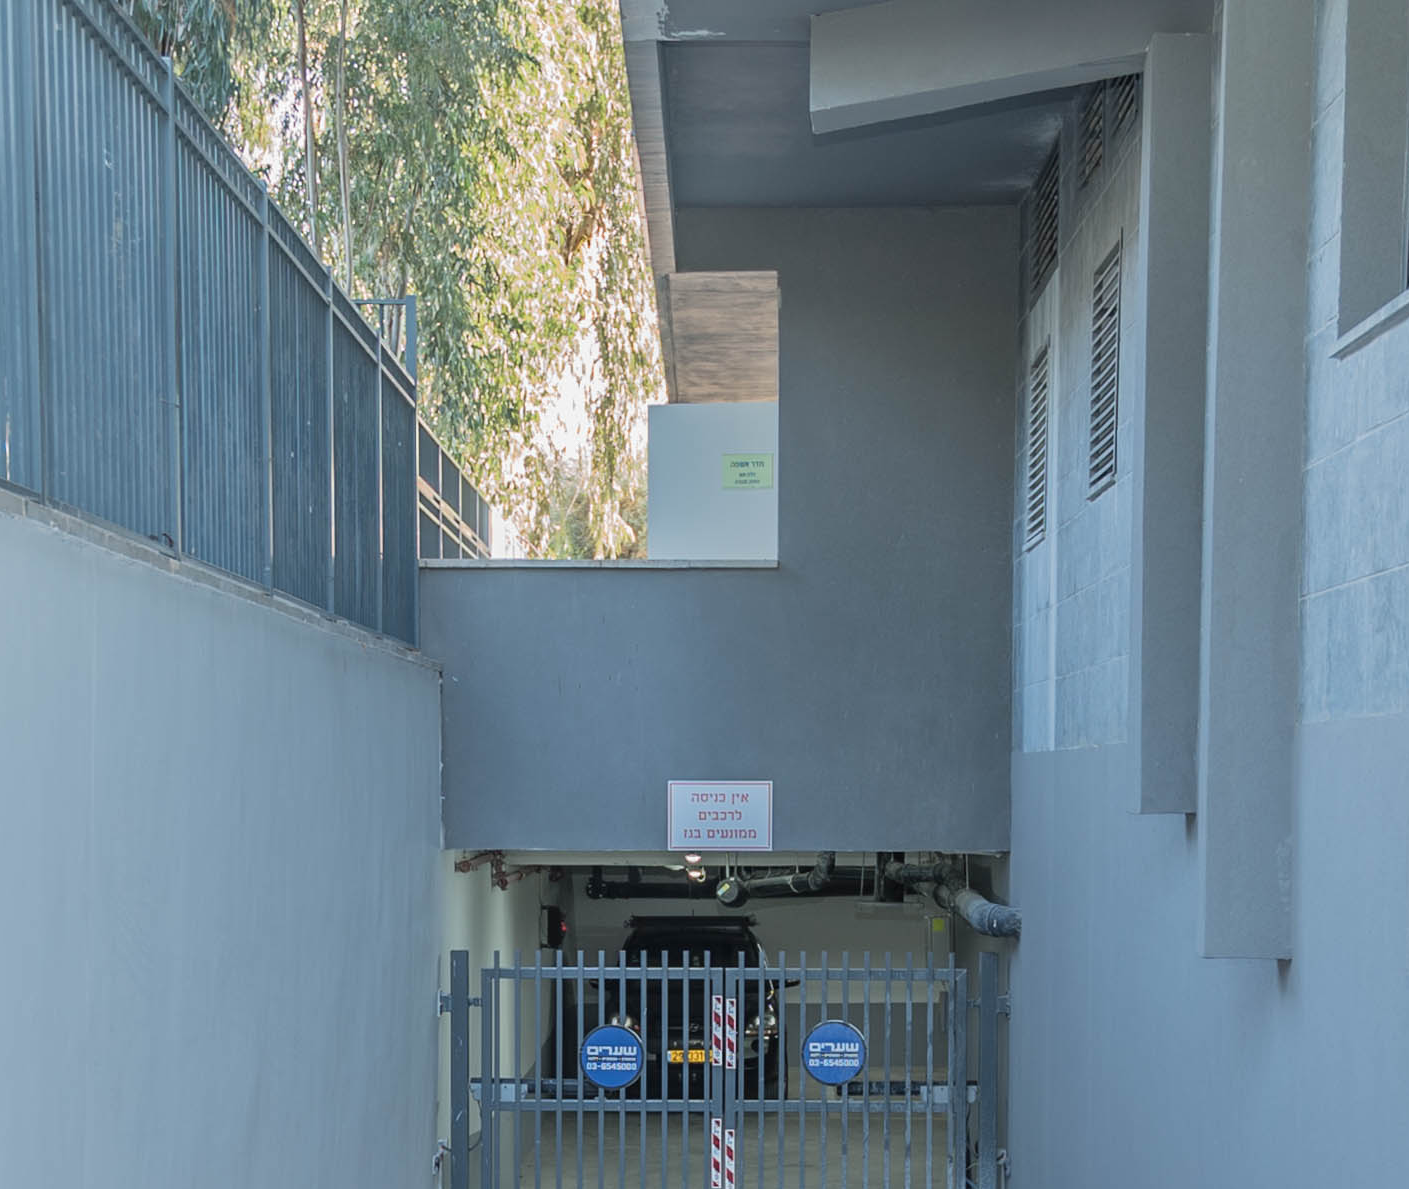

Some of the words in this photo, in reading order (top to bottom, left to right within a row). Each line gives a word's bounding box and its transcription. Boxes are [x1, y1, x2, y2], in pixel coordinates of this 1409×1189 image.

[691, 792, 726, 803] כניסה
[731, 792, 750, 805] אין
[698, 809, 742, 821] לרכבים
[707, 828, 757, 840] ממונעים
[586, 1046, 637, 1056] שערים
[809, 1042, 859, 1052] שערים
